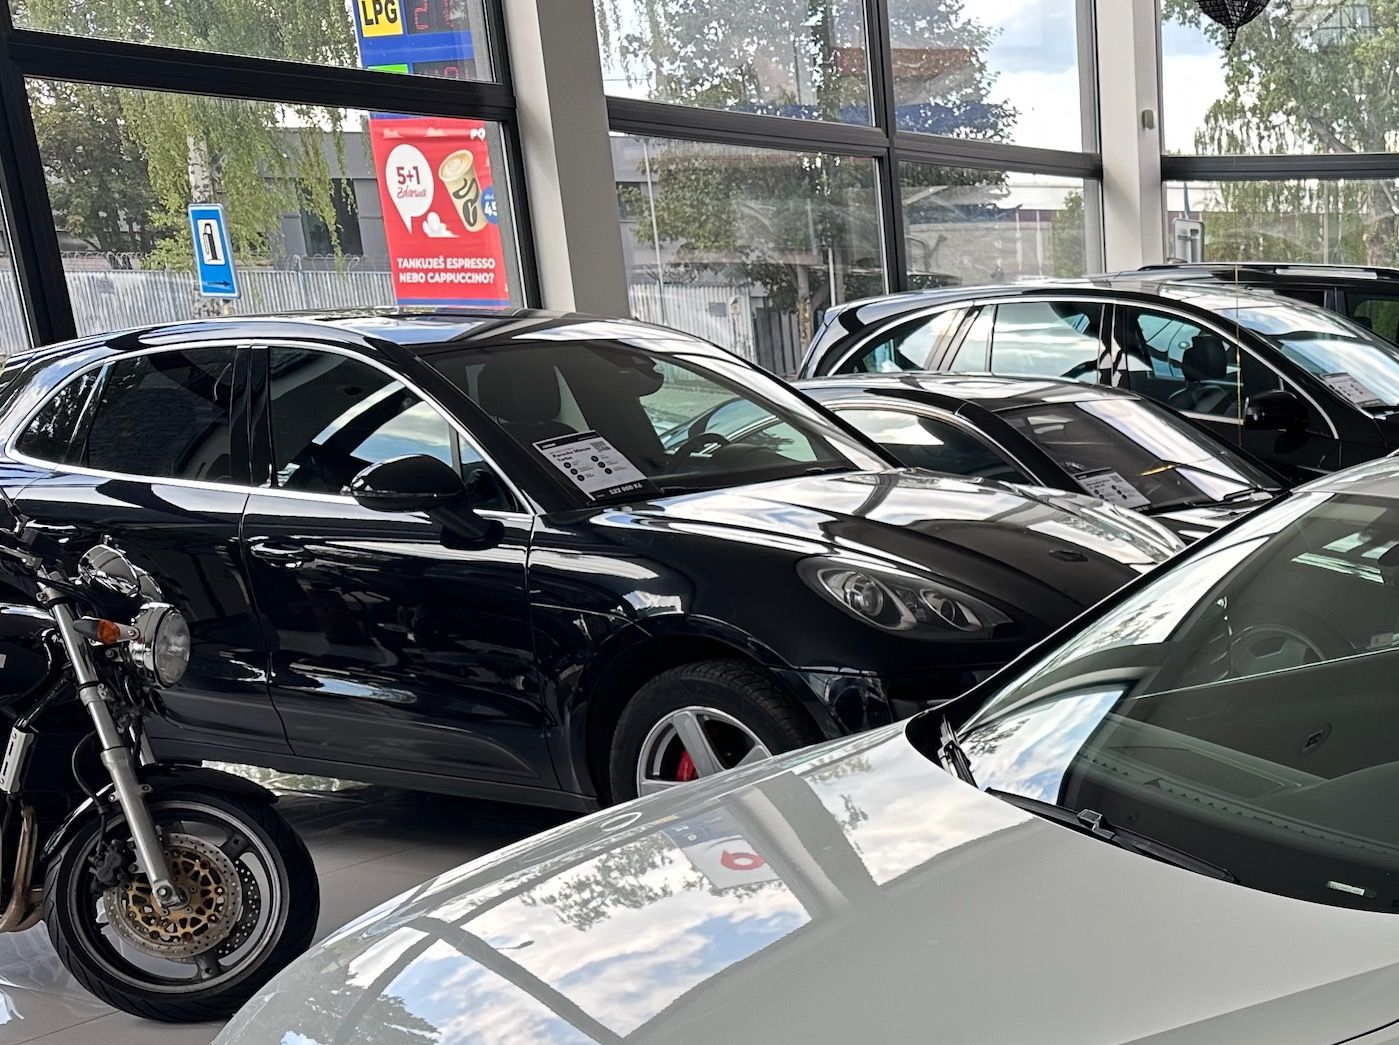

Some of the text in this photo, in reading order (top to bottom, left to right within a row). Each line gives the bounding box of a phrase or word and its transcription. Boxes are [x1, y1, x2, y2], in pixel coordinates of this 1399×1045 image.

[362, 0, 398, 26] LPG
[396, 166, 420, 185] 5+1
[397, 255, 496, 270] TANKUJEŠ ESPRESSO
[399, 271, 495, 285] NEBO CAPPUCCINO?
